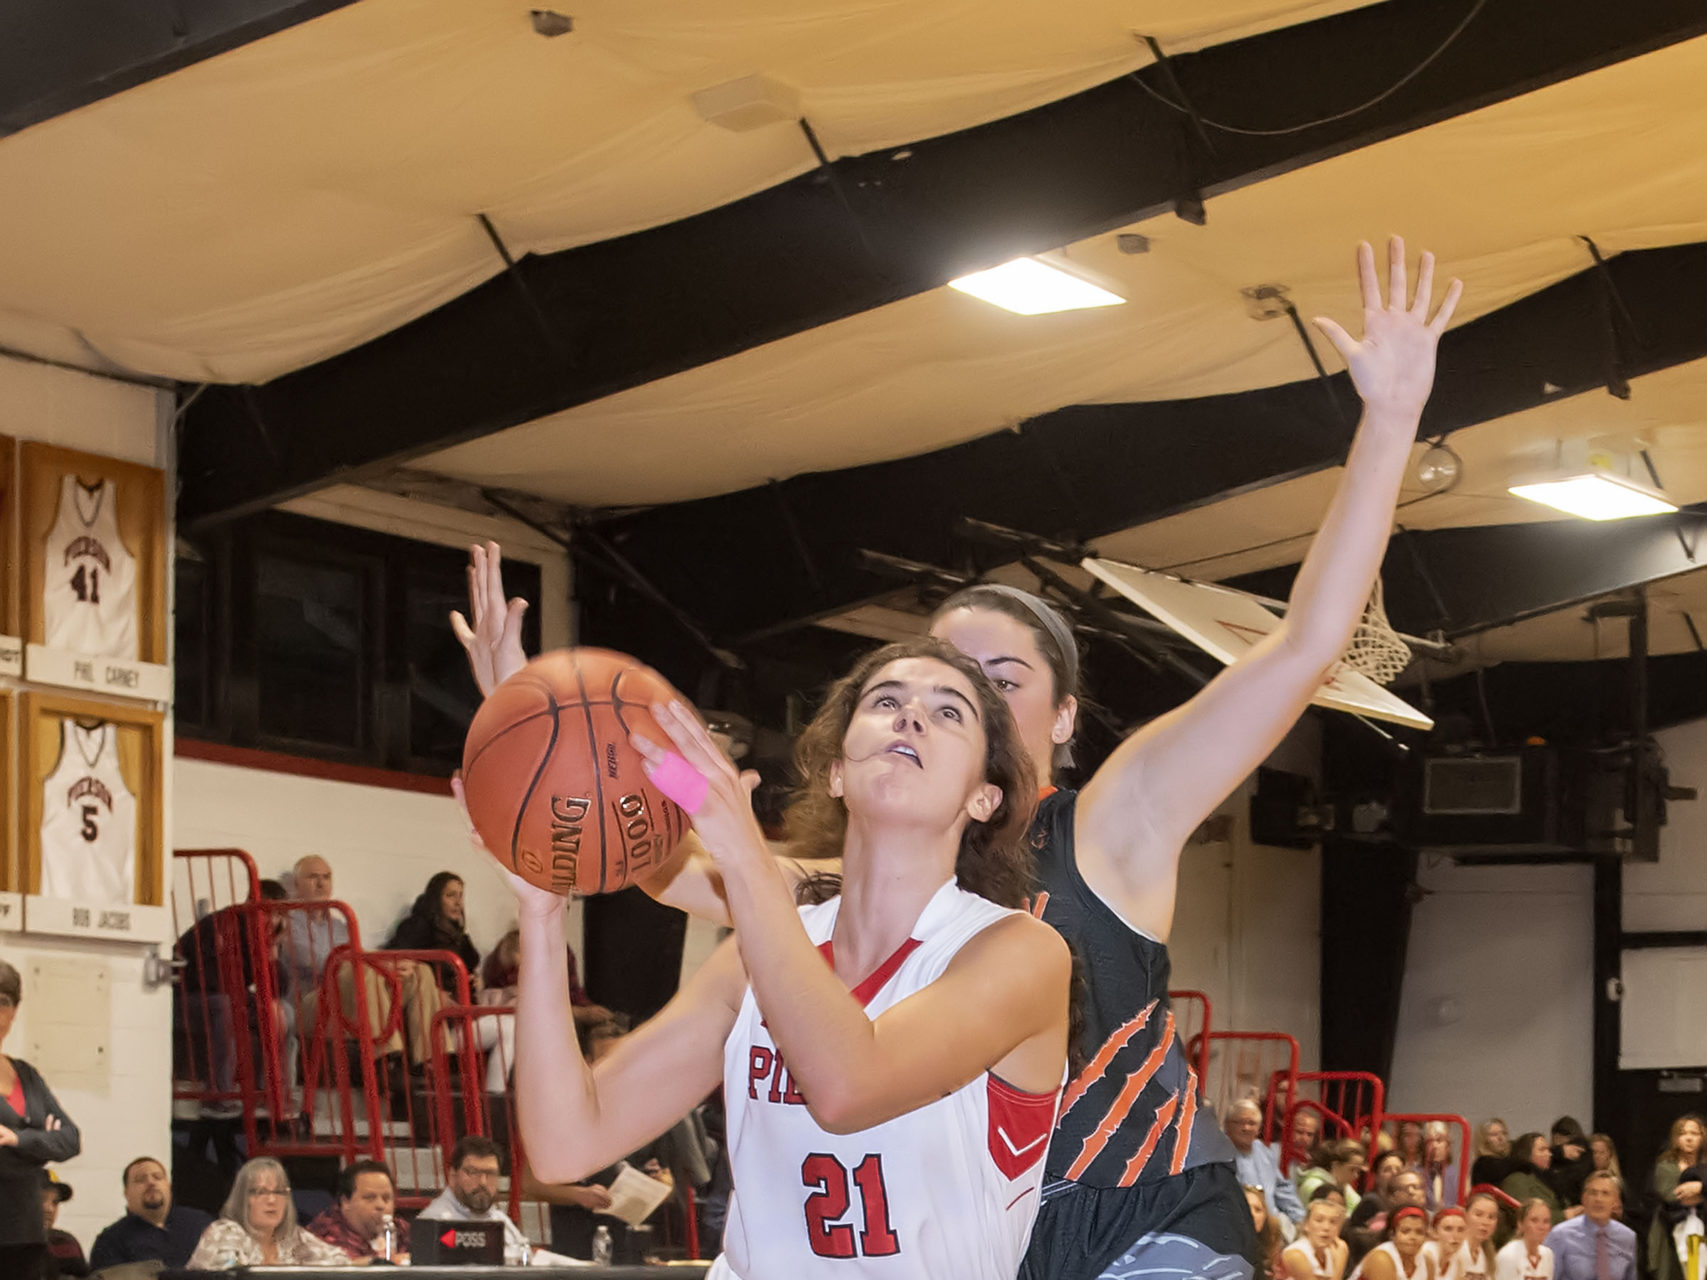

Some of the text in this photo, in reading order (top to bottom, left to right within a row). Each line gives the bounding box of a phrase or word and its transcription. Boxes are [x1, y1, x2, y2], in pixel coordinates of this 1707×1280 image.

[70, 564, 100, 604] 41
[80, 805, 99, 842] 5
[801, 1151, 902, 1260] 21
